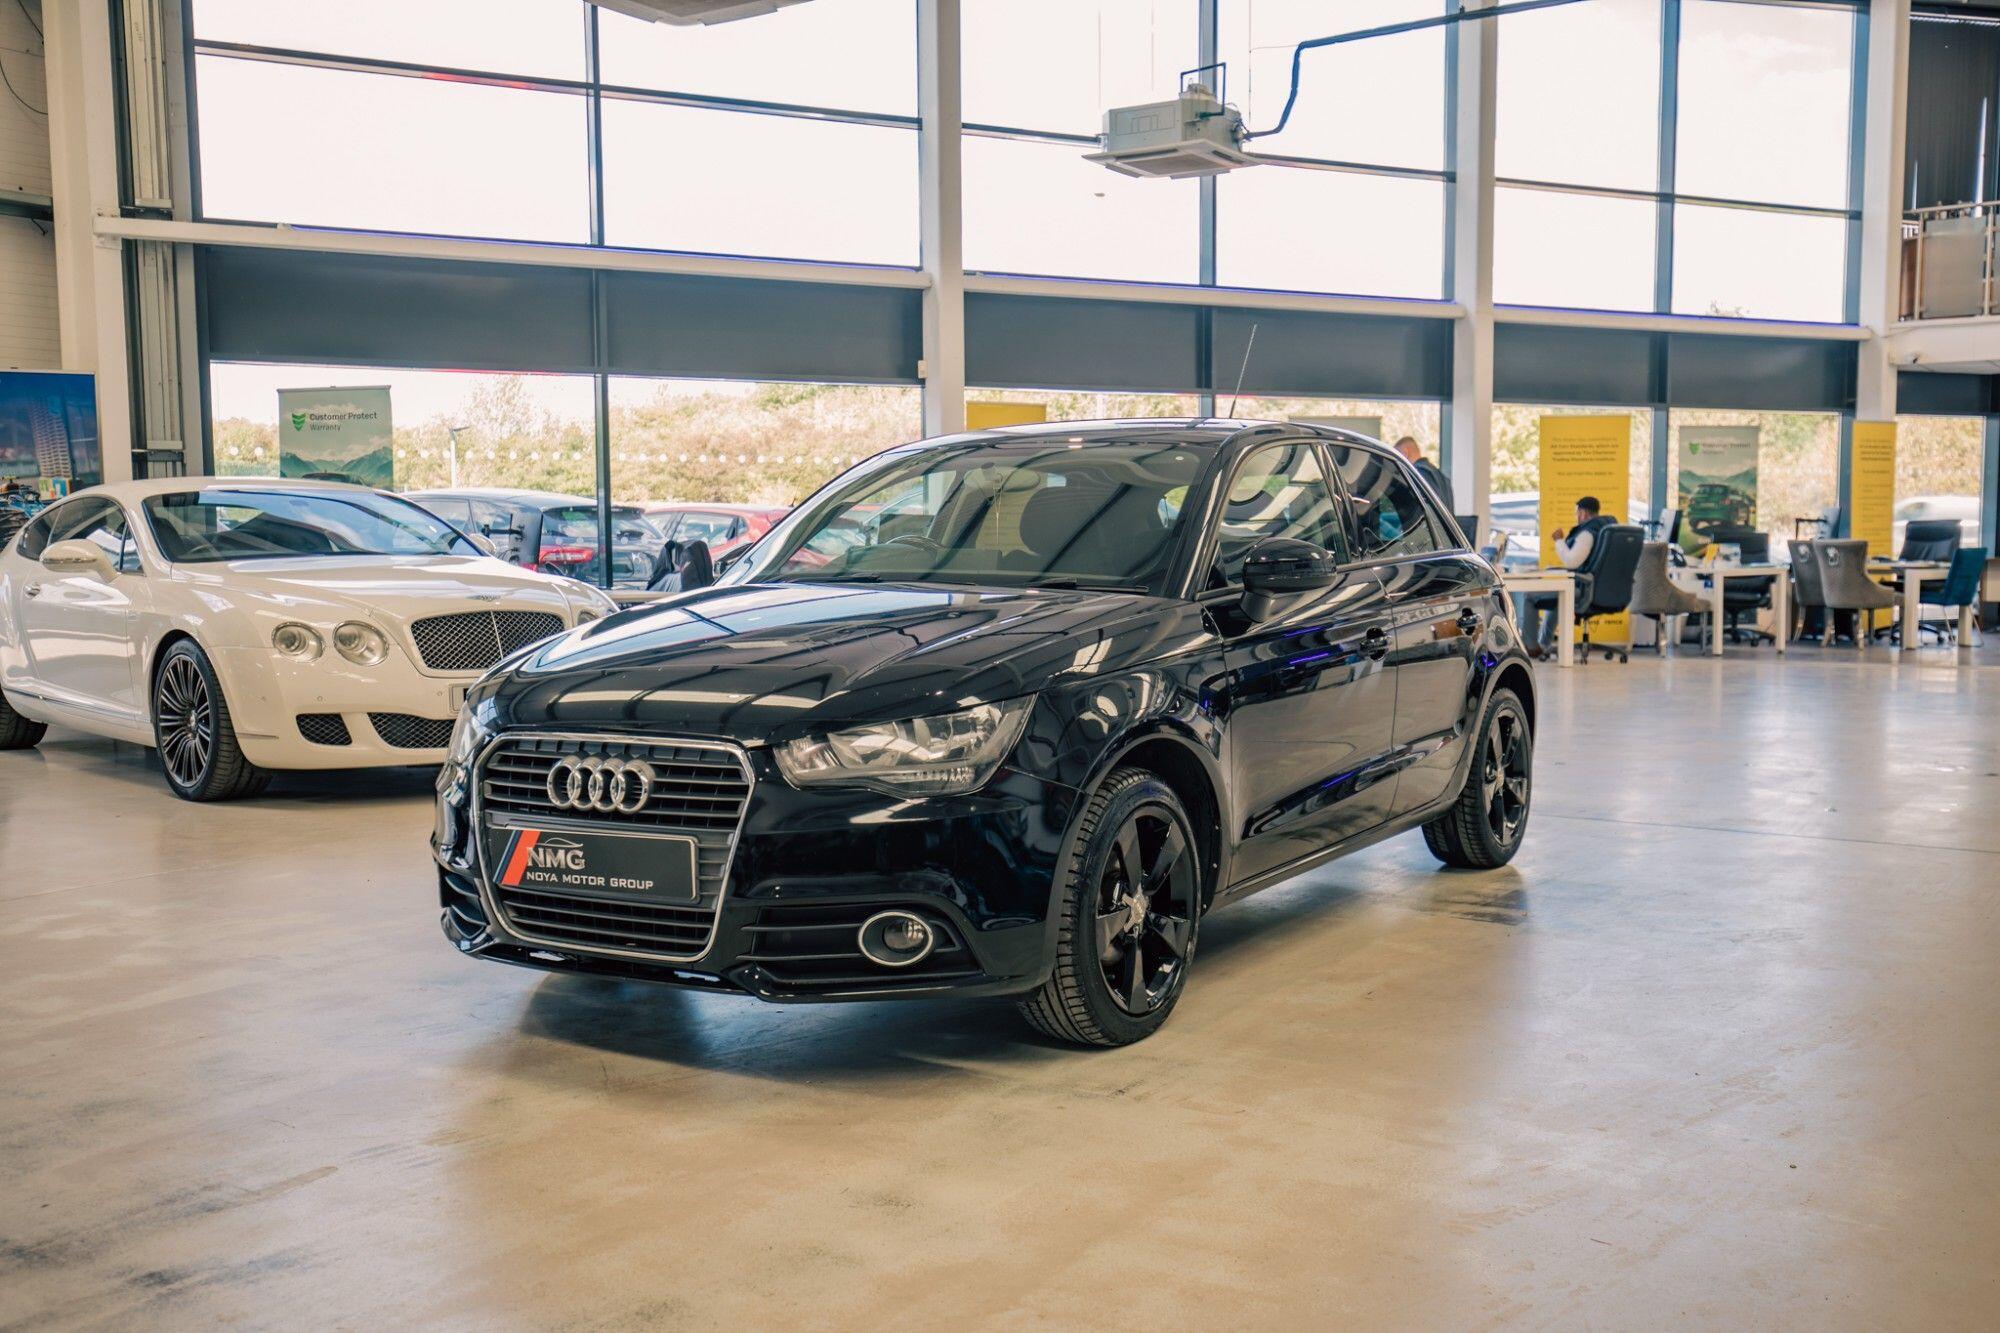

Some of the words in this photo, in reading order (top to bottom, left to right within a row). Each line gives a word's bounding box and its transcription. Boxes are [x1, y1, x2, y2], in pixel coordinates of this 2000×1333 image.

[310, 413, 346, 421] Customer
[348, 412, 377, 420] Protect
[526, 847, 586, 870] NMG
[526, 872, 559, 883] NOYA
[562, 874, 605, 886] MOTOR
[610, 877, 654, 890] GROUP
